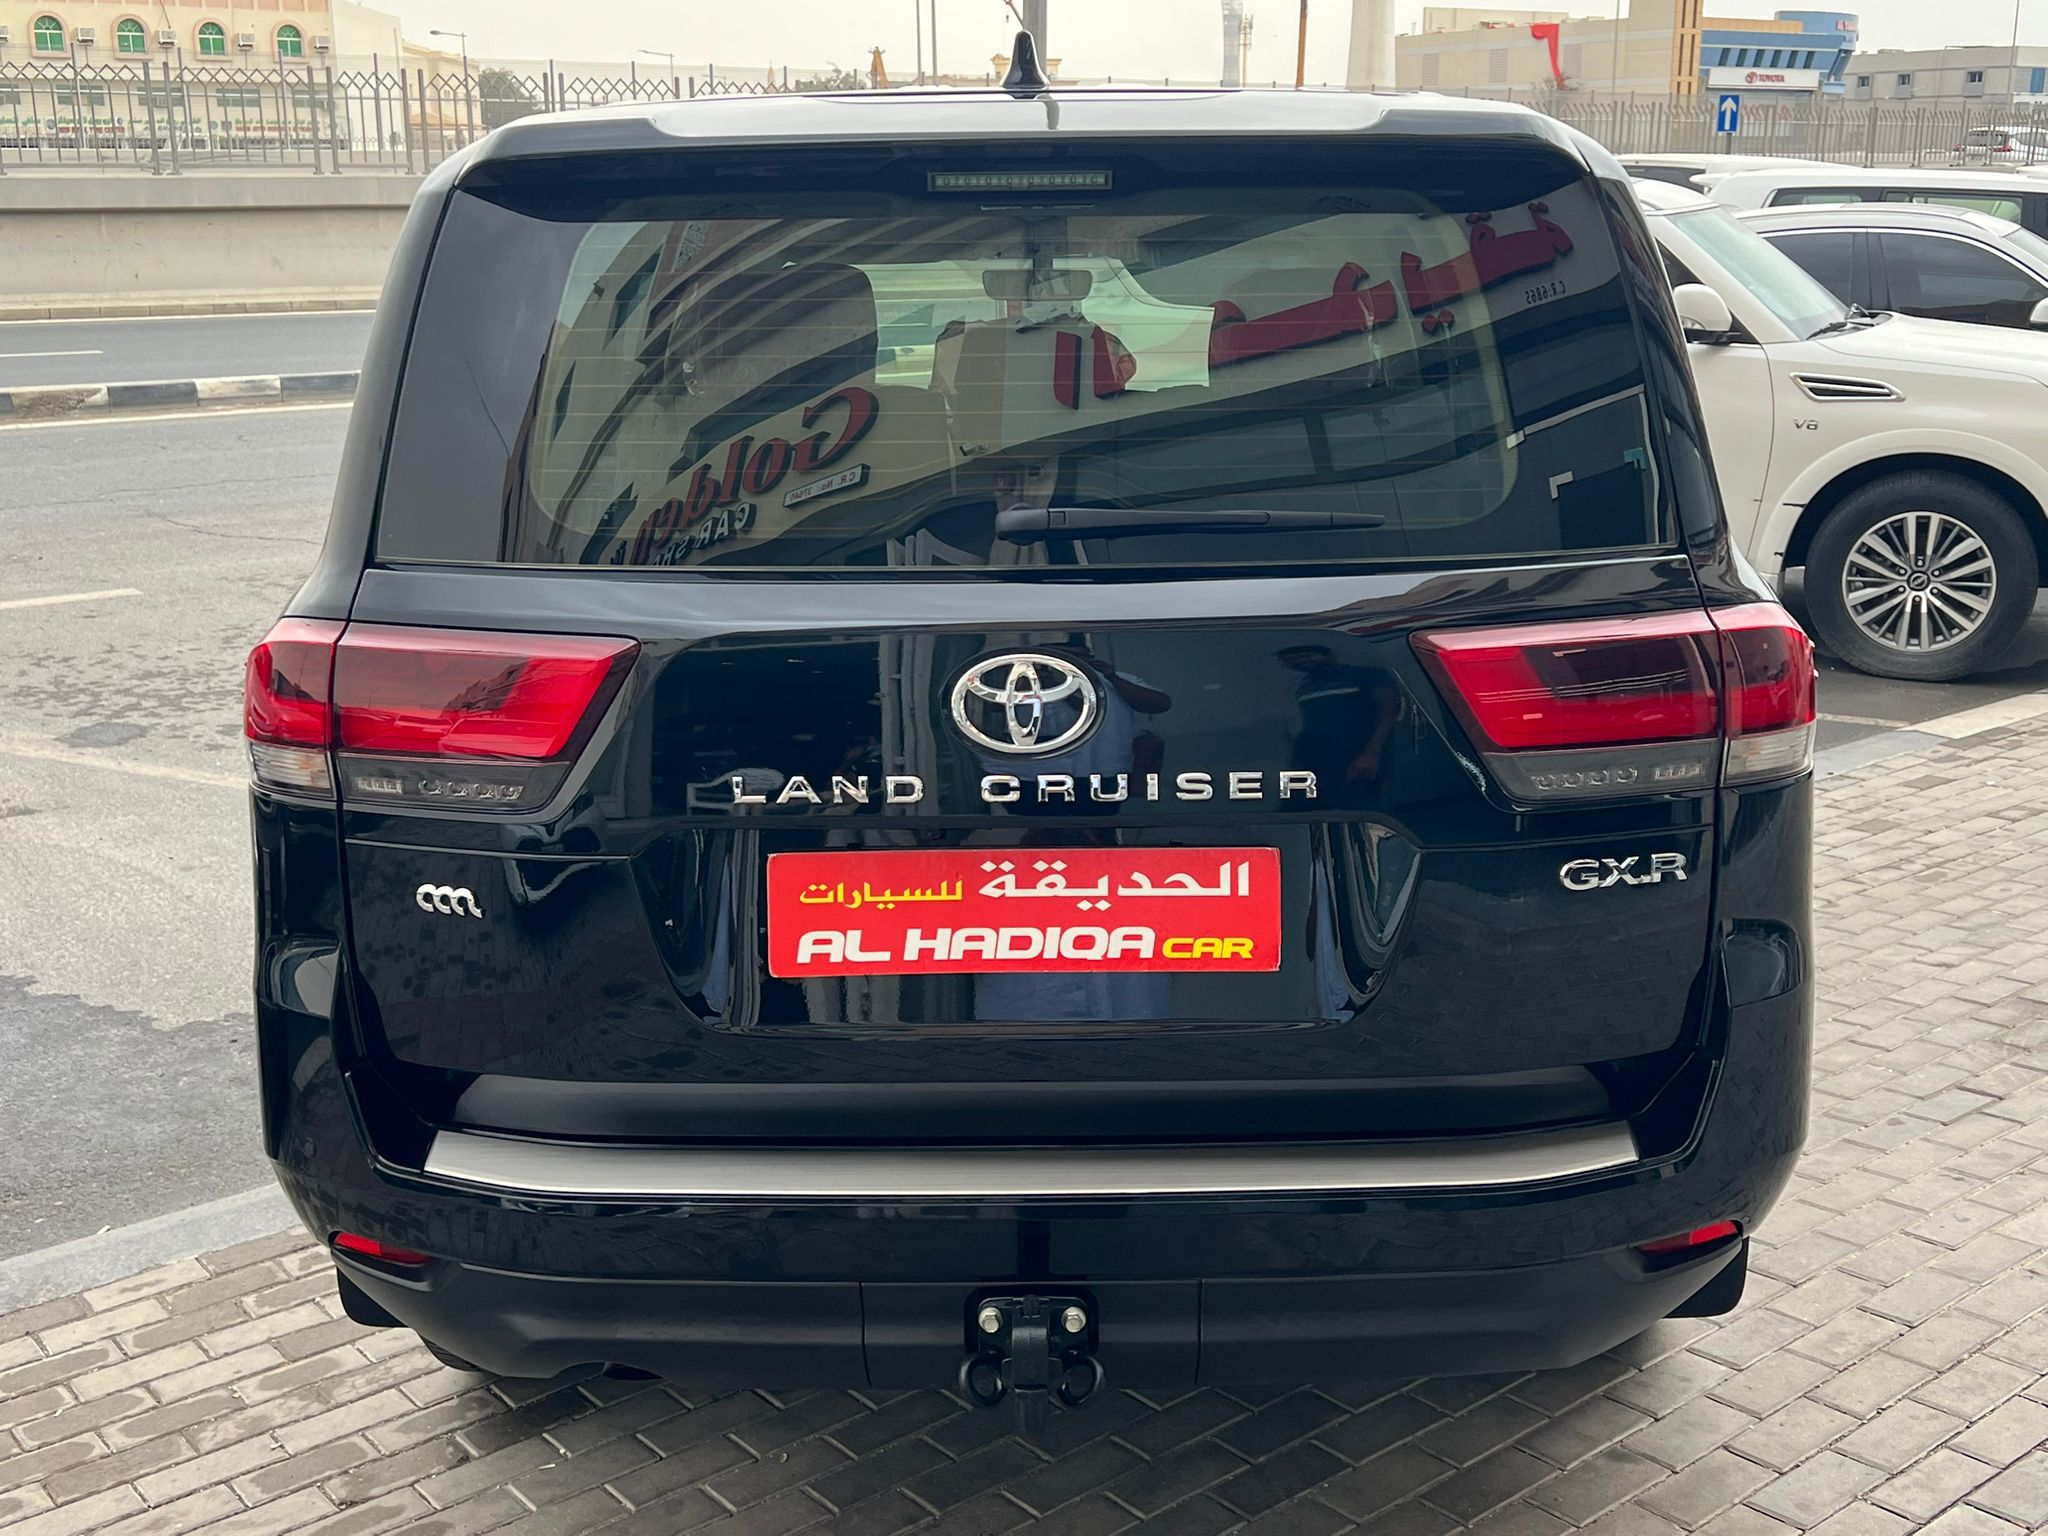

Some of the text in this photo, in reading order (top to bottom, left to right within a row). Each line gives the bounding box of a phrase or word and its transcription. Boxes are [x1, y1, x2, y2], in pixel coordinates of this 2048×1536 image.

[732, 770, 1318, 804] LAND CRUISER
[799, 860, 1250, 912] الحديقة للسيارات
[796, 926, 1254, 964] AL HADIQA CAR
